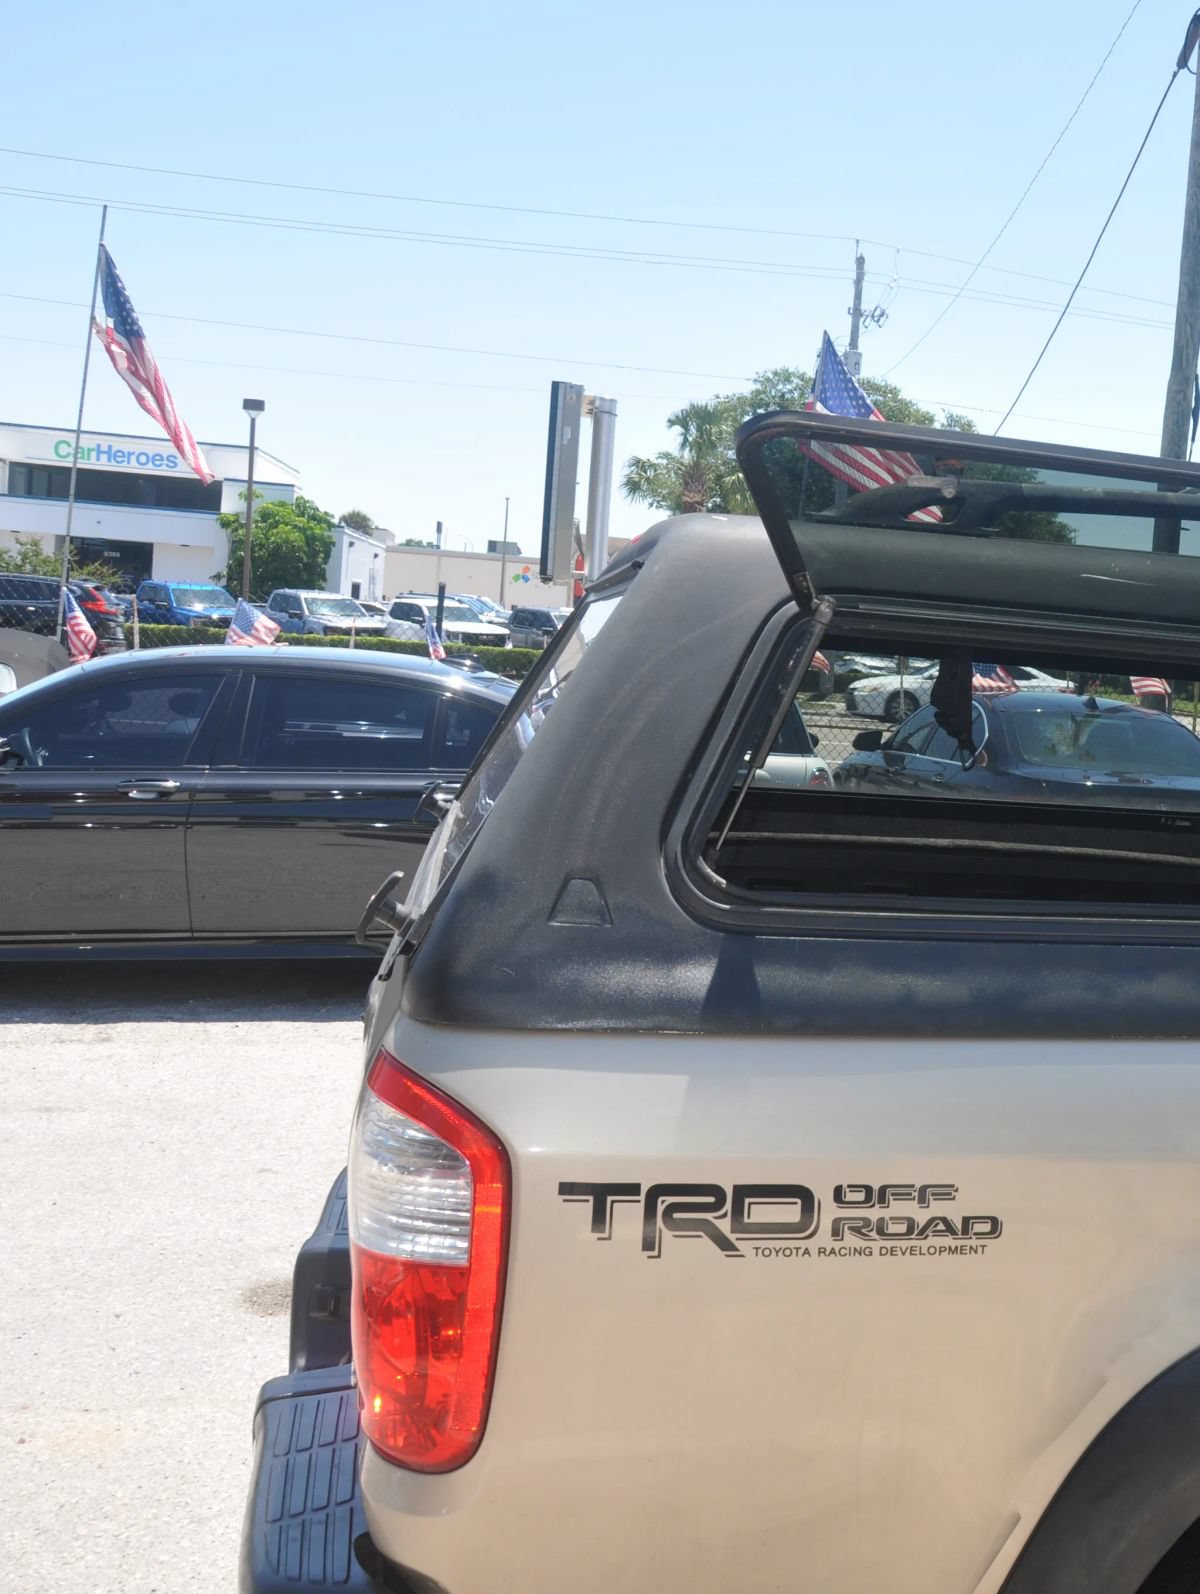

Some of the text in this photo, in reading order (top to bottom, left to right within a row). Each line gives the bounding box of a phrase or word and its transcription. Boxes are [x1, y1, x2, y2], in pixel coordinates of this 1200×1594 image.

[54, 440, 178, 469] CarHeroes
[558, 1181, 959, 1259] TRD OFF
[830, 1216, 1003, 1241] ROAD
[752, 1244, 988, 1258] TOYOTA RACING DEVELOPMENT
